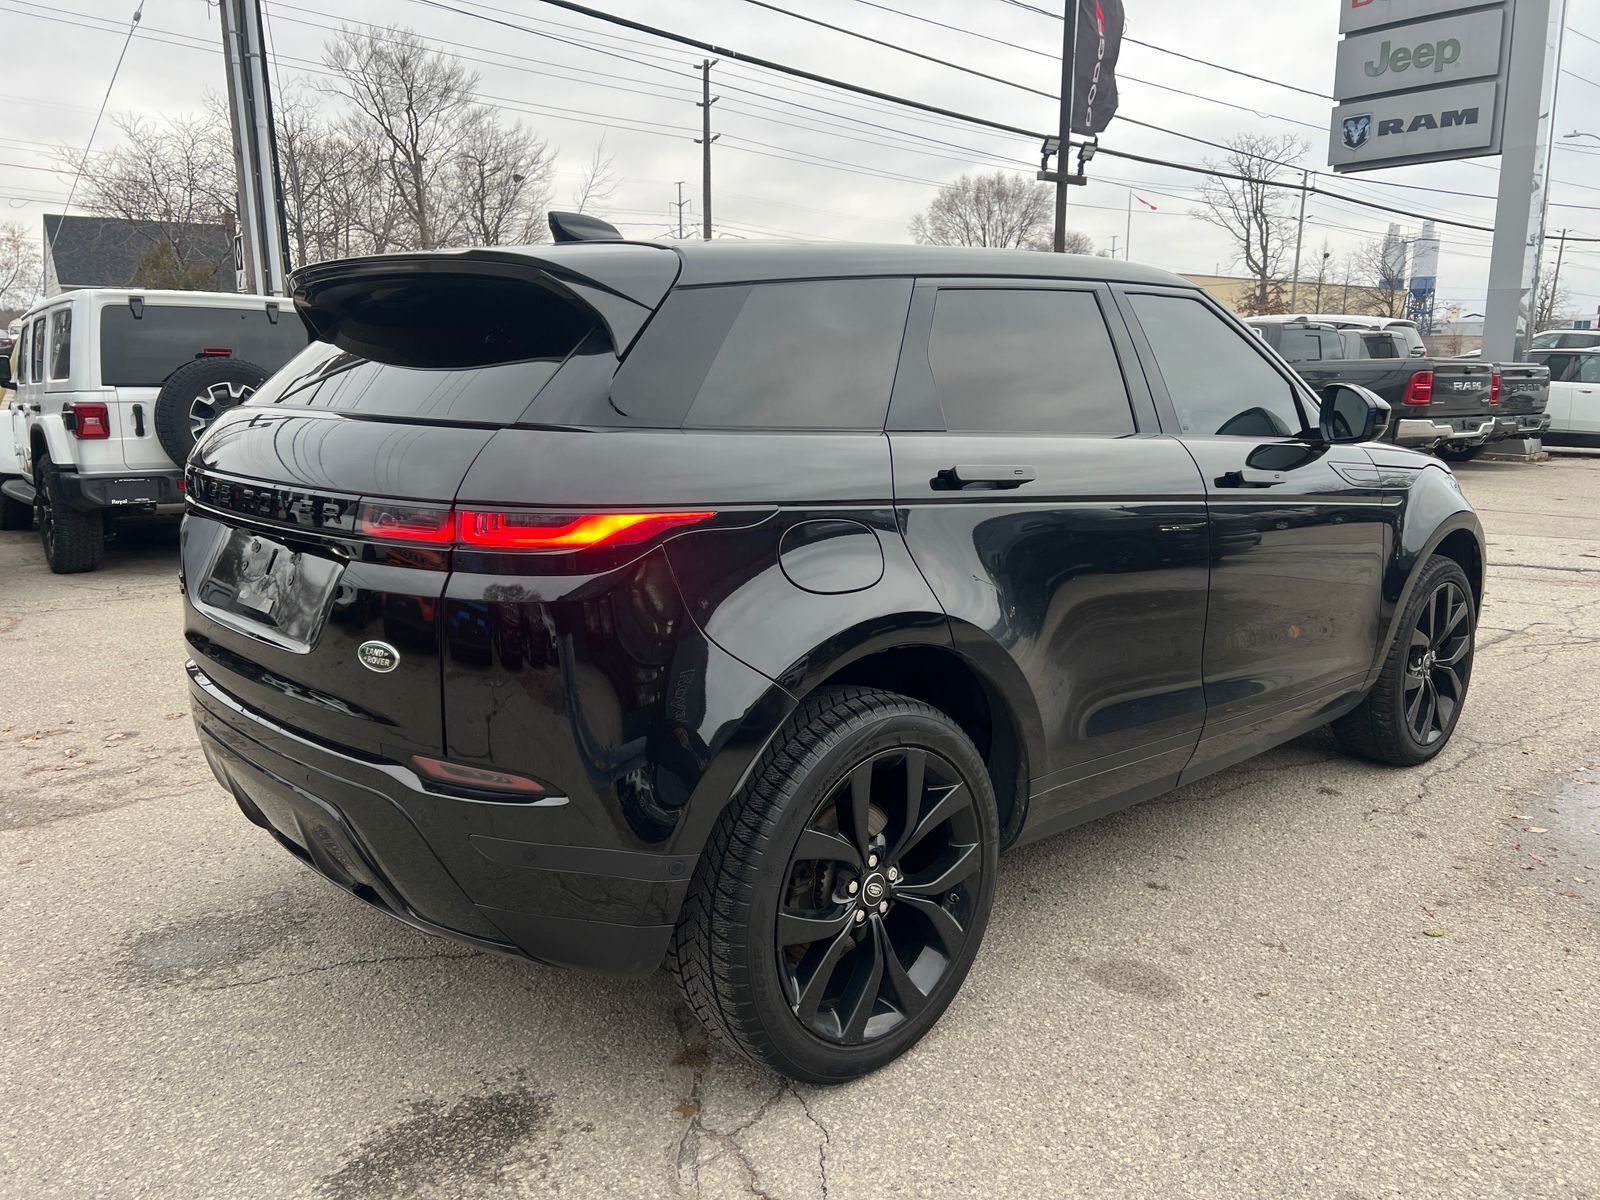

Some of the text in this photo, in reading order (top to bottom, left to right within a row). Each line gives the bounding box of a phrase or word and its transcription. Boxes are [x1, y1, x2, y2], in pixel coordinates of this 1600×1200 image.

[1364, 37, 1461, 77] Jeep
[1378, 107, 1479, 136] RAM
[1453, 382, 1482, 391] RAM
[365, 646, 384, 657] LAND
[366, 655, 390, 667] ROVER
